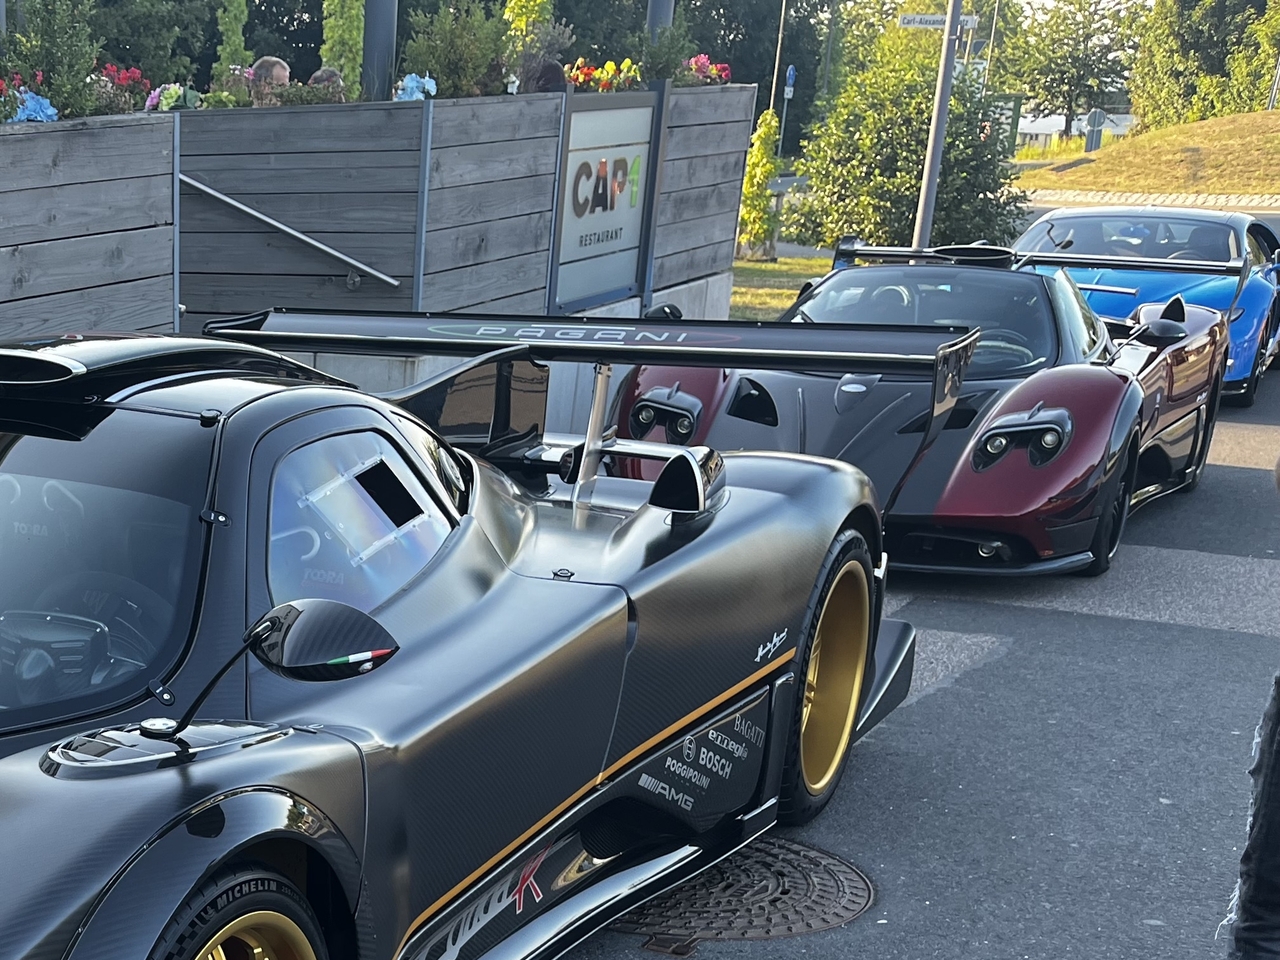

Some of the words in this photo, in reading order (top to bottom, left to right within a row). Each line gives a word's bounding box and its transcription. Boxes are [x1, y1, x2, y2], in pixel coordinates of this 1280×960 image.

[572, 155, 641, 219] CAP1
[579, 227, 623, 247] RESTAURANT
[475, 326, 688, 342] PAGANI
[664, 756, 711, 790] POGGIPOLINI
[699, 746, 733, 780] BOSCH
[656, 782, 695, 811] AMG
[216, 879, 277, 910] MICHELIN
